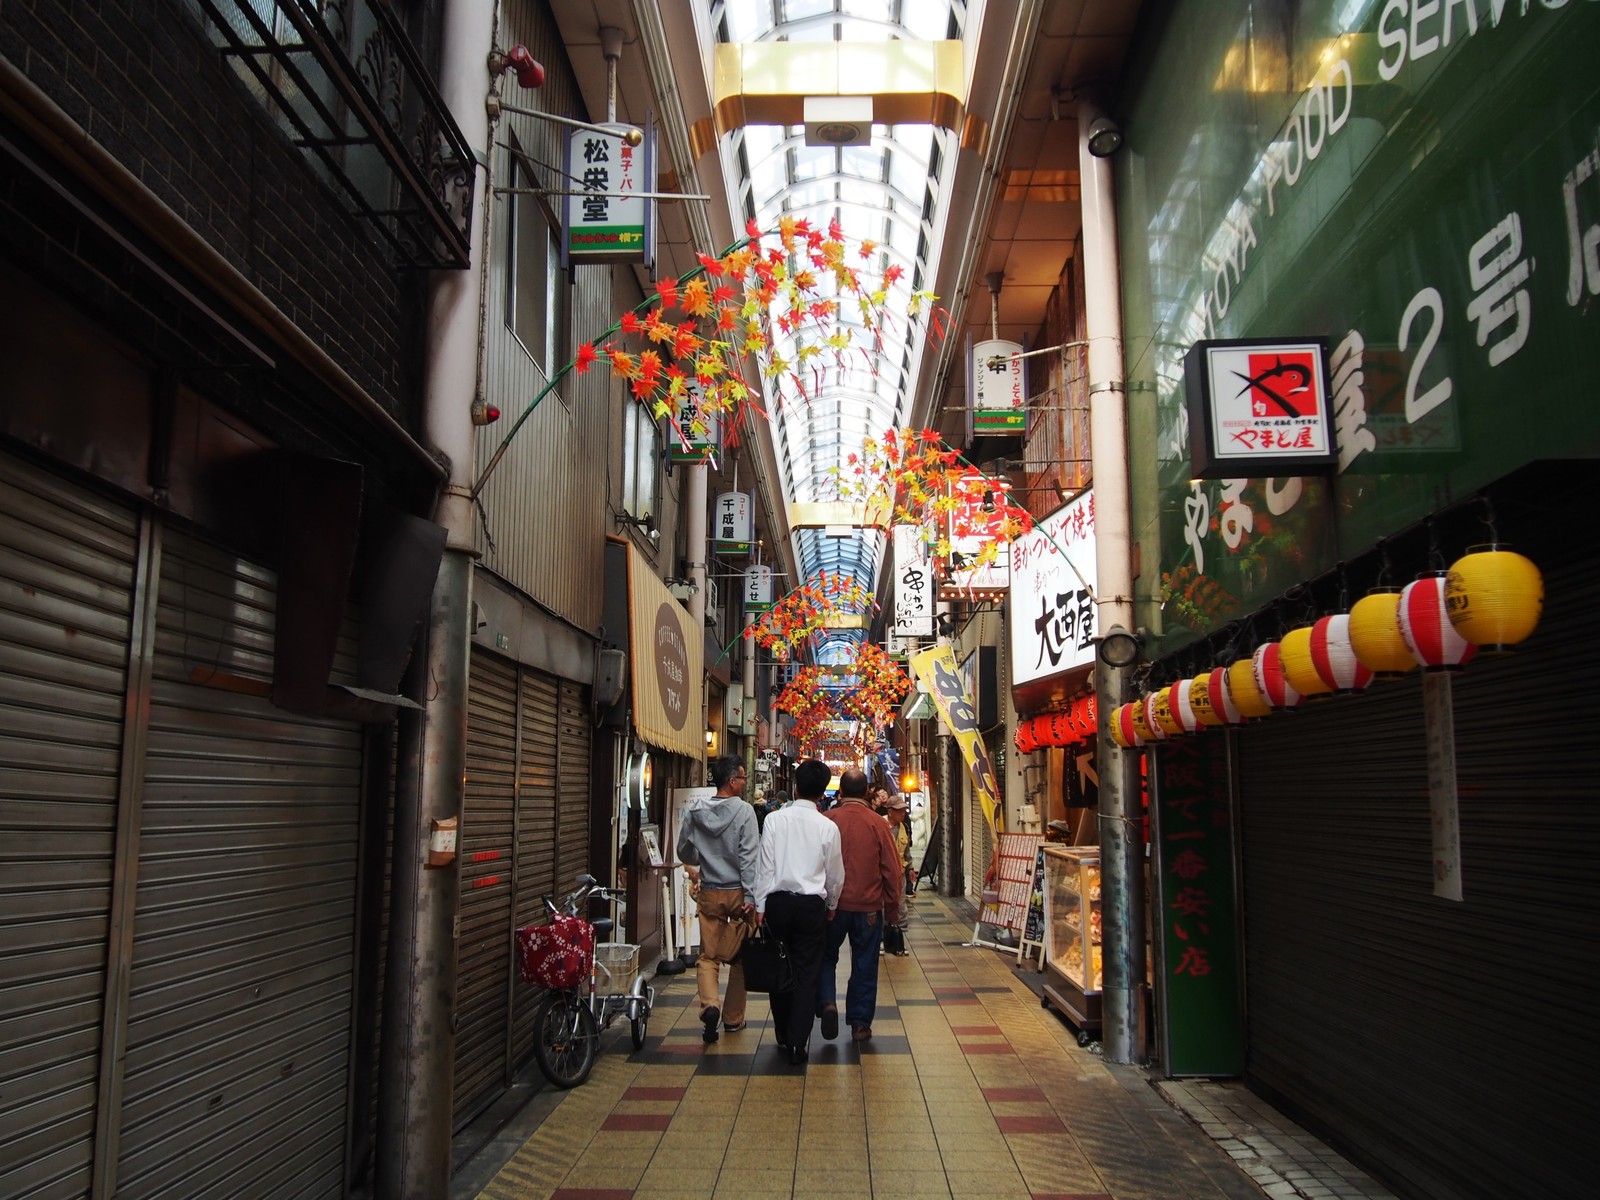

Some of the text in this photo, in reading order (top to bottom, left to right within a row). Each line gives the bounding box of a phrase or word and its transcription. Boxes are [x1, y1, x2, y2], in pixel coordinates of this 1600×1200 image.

[619, 138, 633, 201] 菓子・パ
[1262, 59, 1352, 217] FOOD
[583, 138, 609, 222] 松栄堂
[1229, 426, 1315, 450] やまと屋
[722, 499, 735, 539] 千成屋
[749, 570, 759, 601] ちとせ
[1035, 584, 1095, 671] 大西屋
